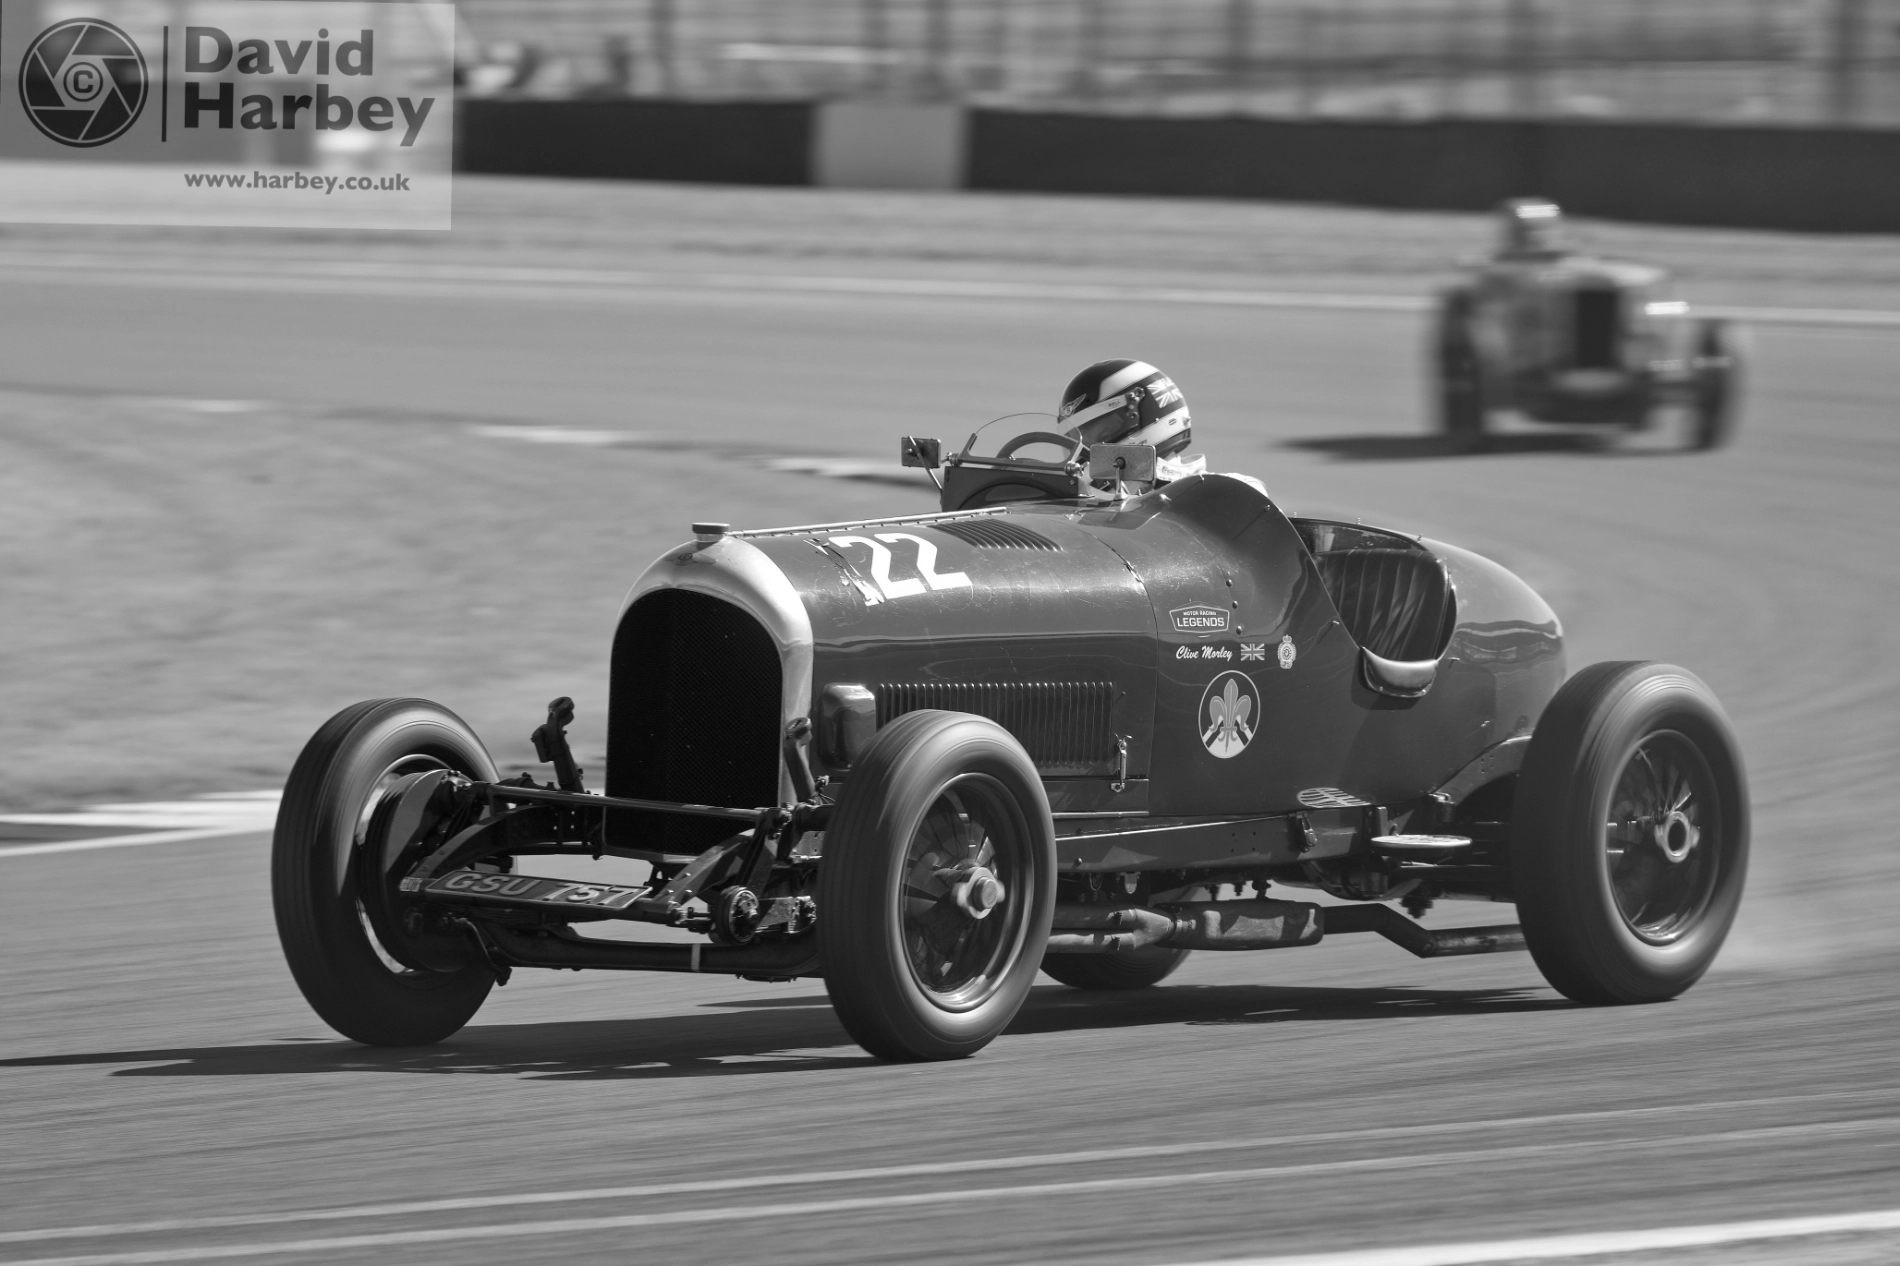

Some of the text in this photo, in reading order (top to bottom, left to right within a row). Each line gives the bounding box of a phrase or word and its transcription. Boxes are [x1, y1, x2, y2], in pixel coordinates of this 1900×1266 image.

[828, 532, 973, 599] 22
[1176, 617, 1225, 627] LEGENDS
[1176, 645, 1233, 662] Clive Morley
[444, 873, 638, 906] GSU 757
